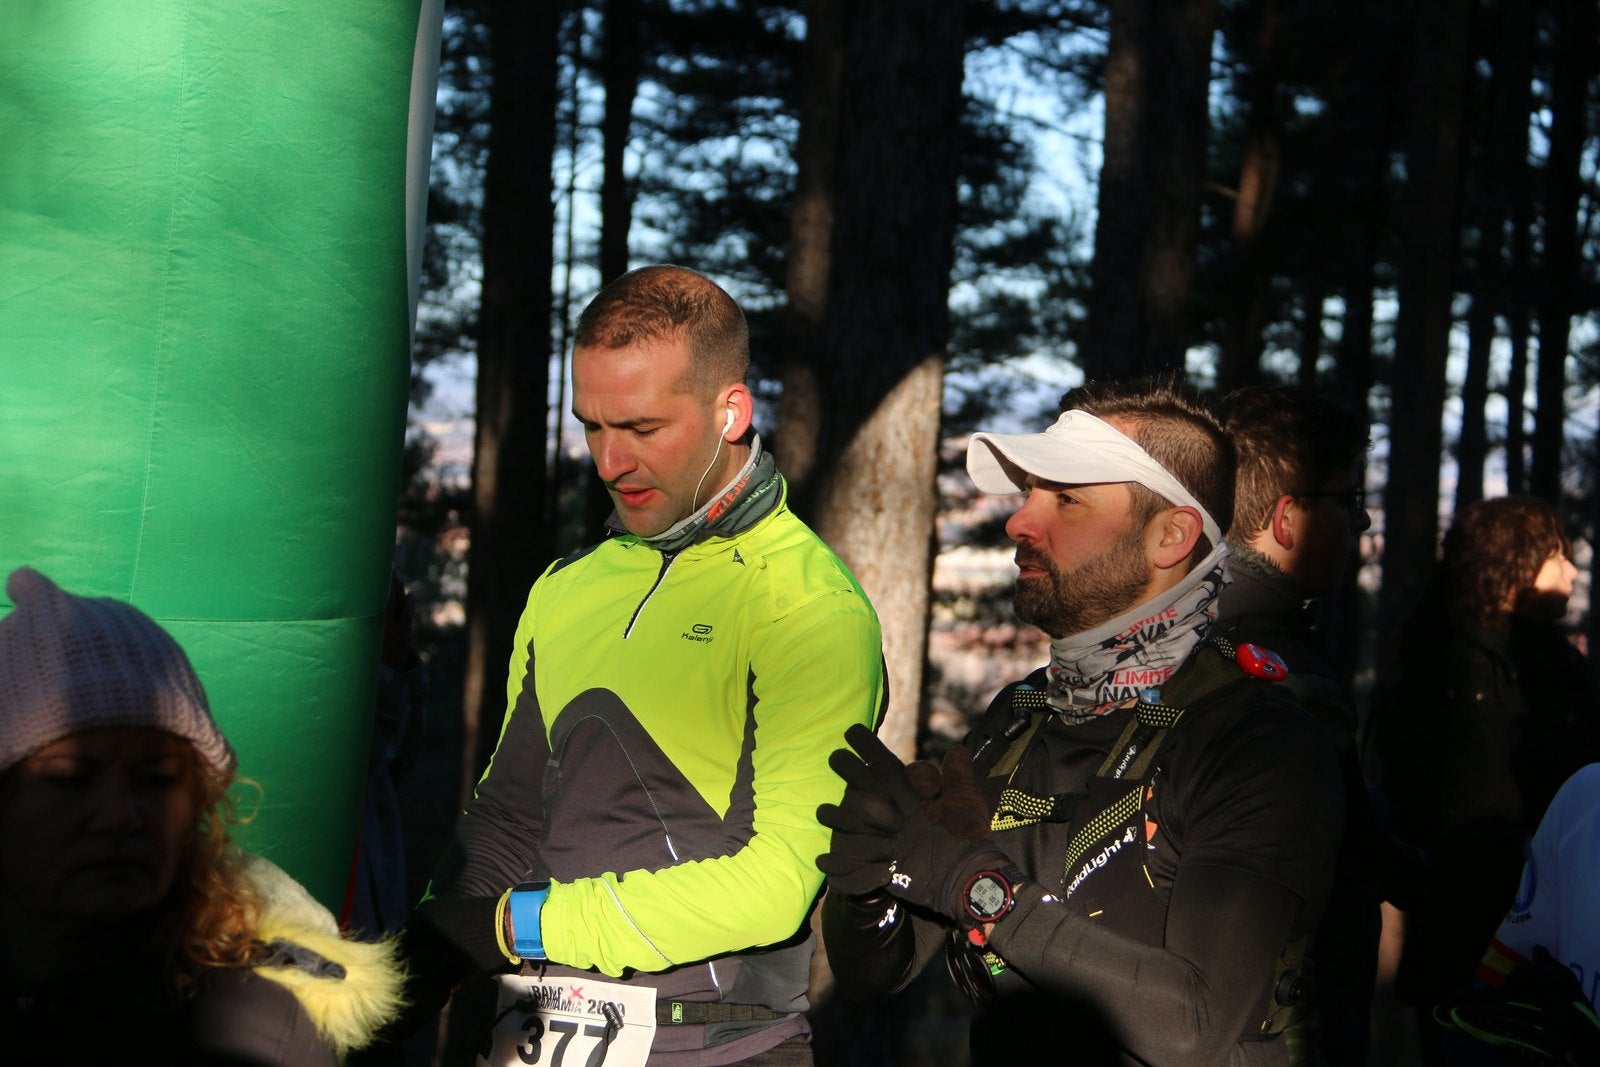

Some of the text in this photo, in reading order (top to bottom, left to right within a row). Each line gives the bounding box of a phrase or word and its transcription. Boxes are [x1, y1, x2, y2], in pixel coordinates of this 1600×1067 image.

[681, 632, 714, 645] Kalenji
[1113, 665, 1174, 685] LIMITE
[1102, 685, 1150, 704] NAV
[516, 1015, 615, 1067] 377
